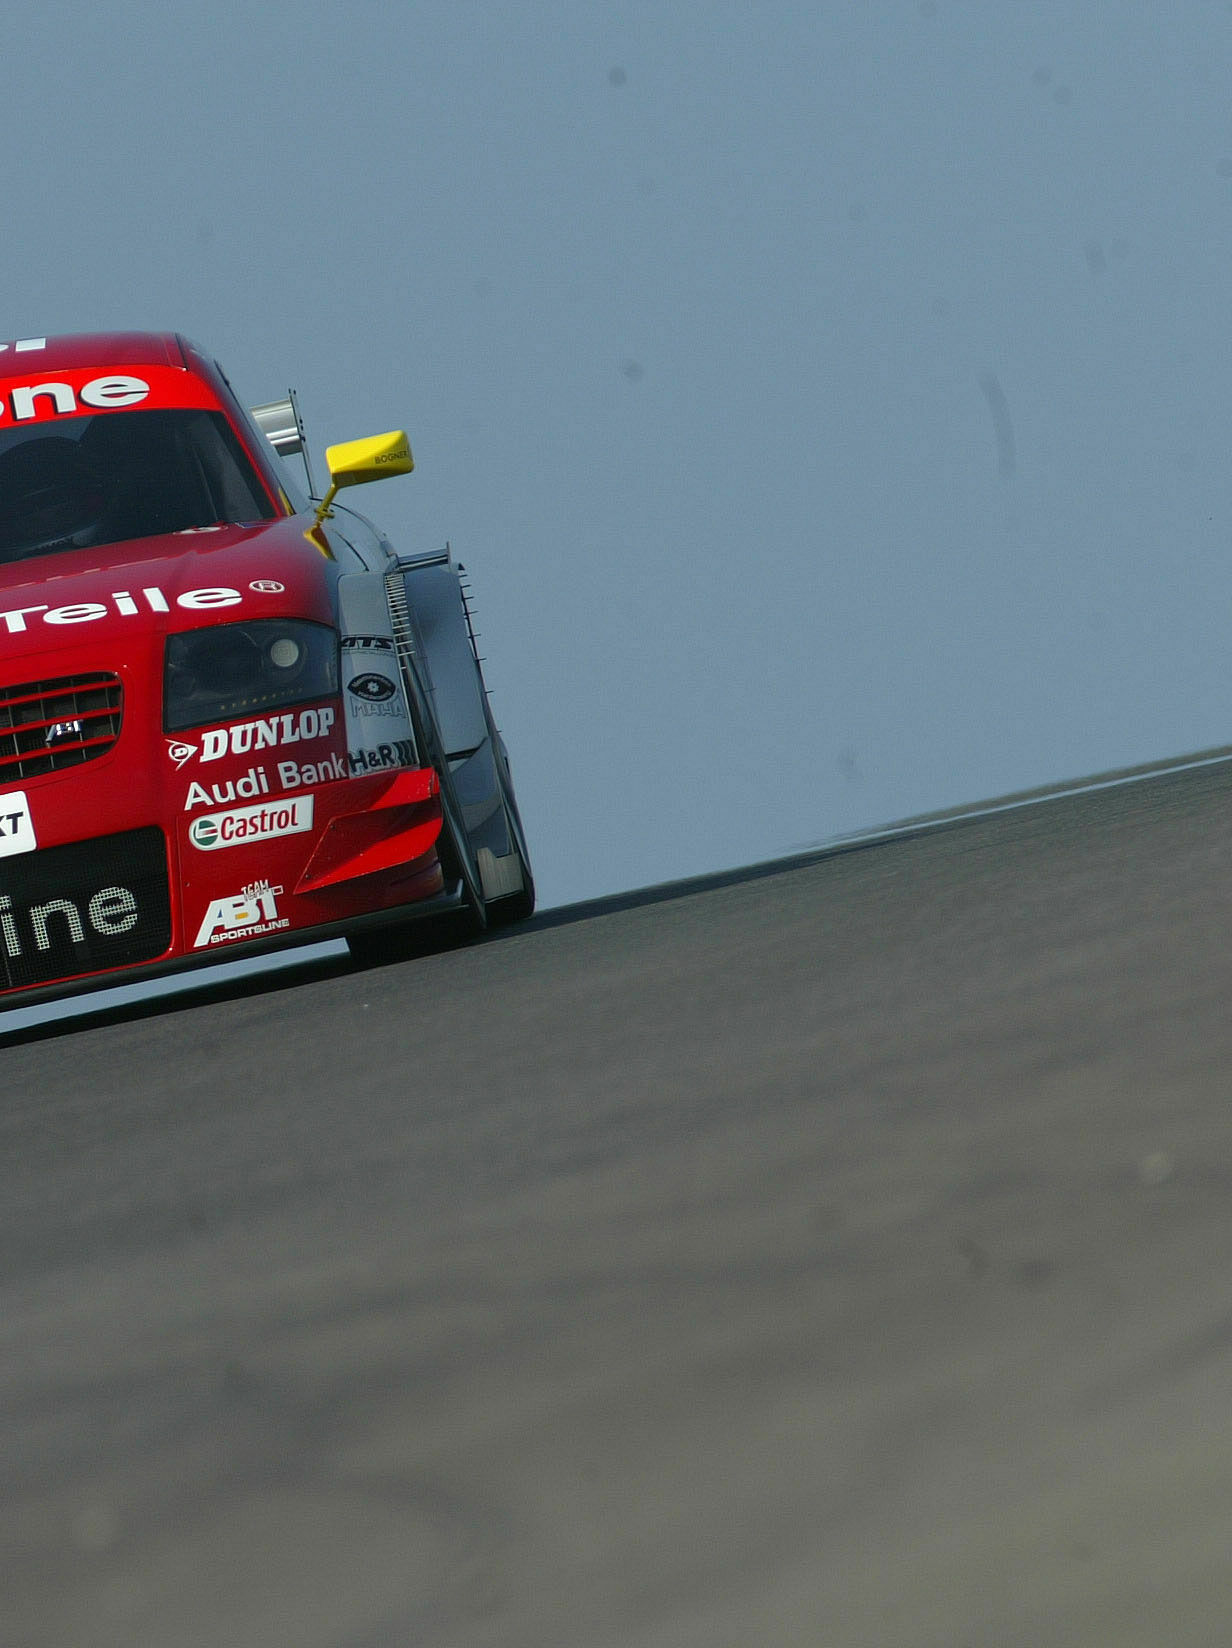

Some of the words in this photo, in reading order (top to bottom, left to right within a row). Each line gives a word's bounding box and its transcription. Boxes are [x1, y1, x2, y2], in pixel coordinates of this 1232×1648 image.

[199, 707, 335, 763] DUNLOP
[348, 743, 395, 774] H&R
[184, 766, 269, 811] Audi
[277, 752, 348, 789] Bank
[220, 803, 299, 841] Castrol
[194, 885, 284, 948] ABT
[211, 918, 290, 944] SPORTSLINE
